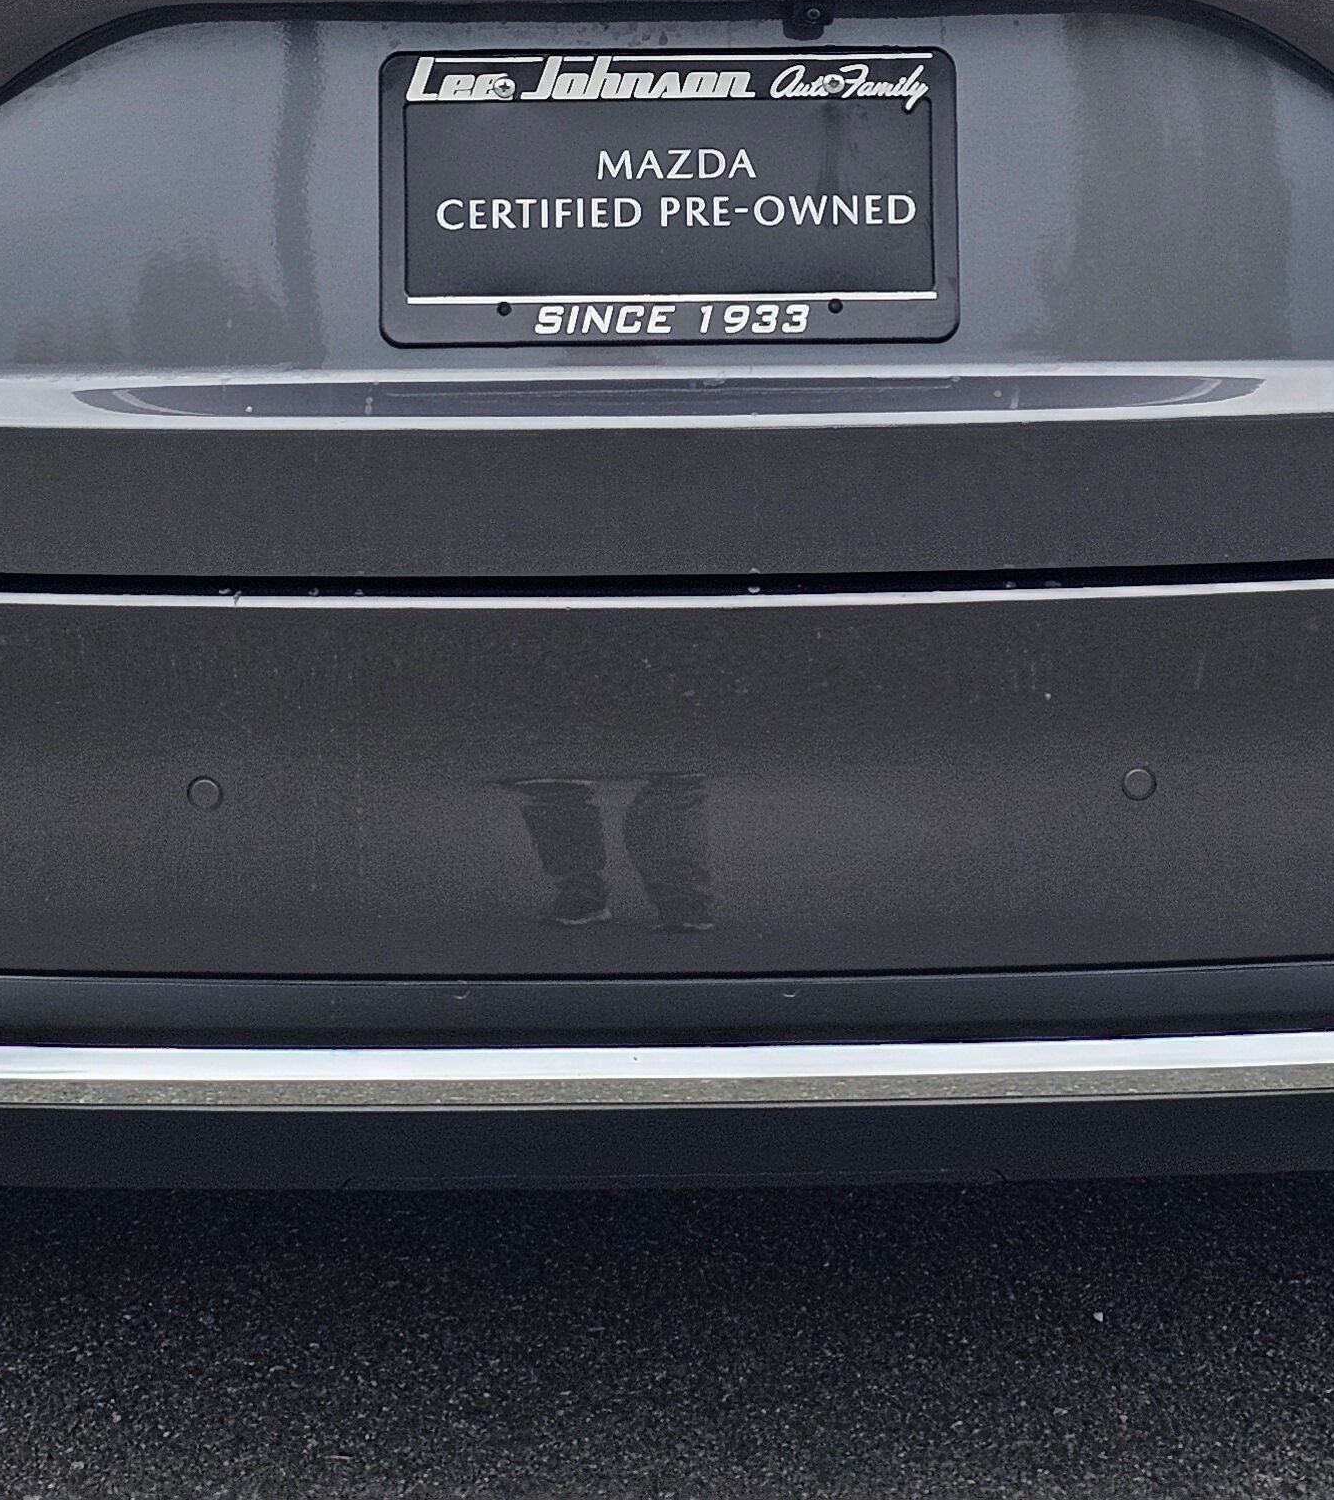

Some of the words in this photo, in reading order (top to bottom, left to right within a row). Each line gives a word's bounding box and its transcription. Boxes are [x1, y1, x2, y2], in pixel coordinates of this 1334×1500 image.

[406, 56, 514, 101] Lee
[520, 55, 756, 100] Johnson
[596, 148, 757, 180] MAZDA
[436, 197, 643, 230] CERTIFIED
[659, 194, 916, 227] PRE-OWNED
[534, 304, 676, 335] SINCE
[698, 303, 811, 334] 1933
